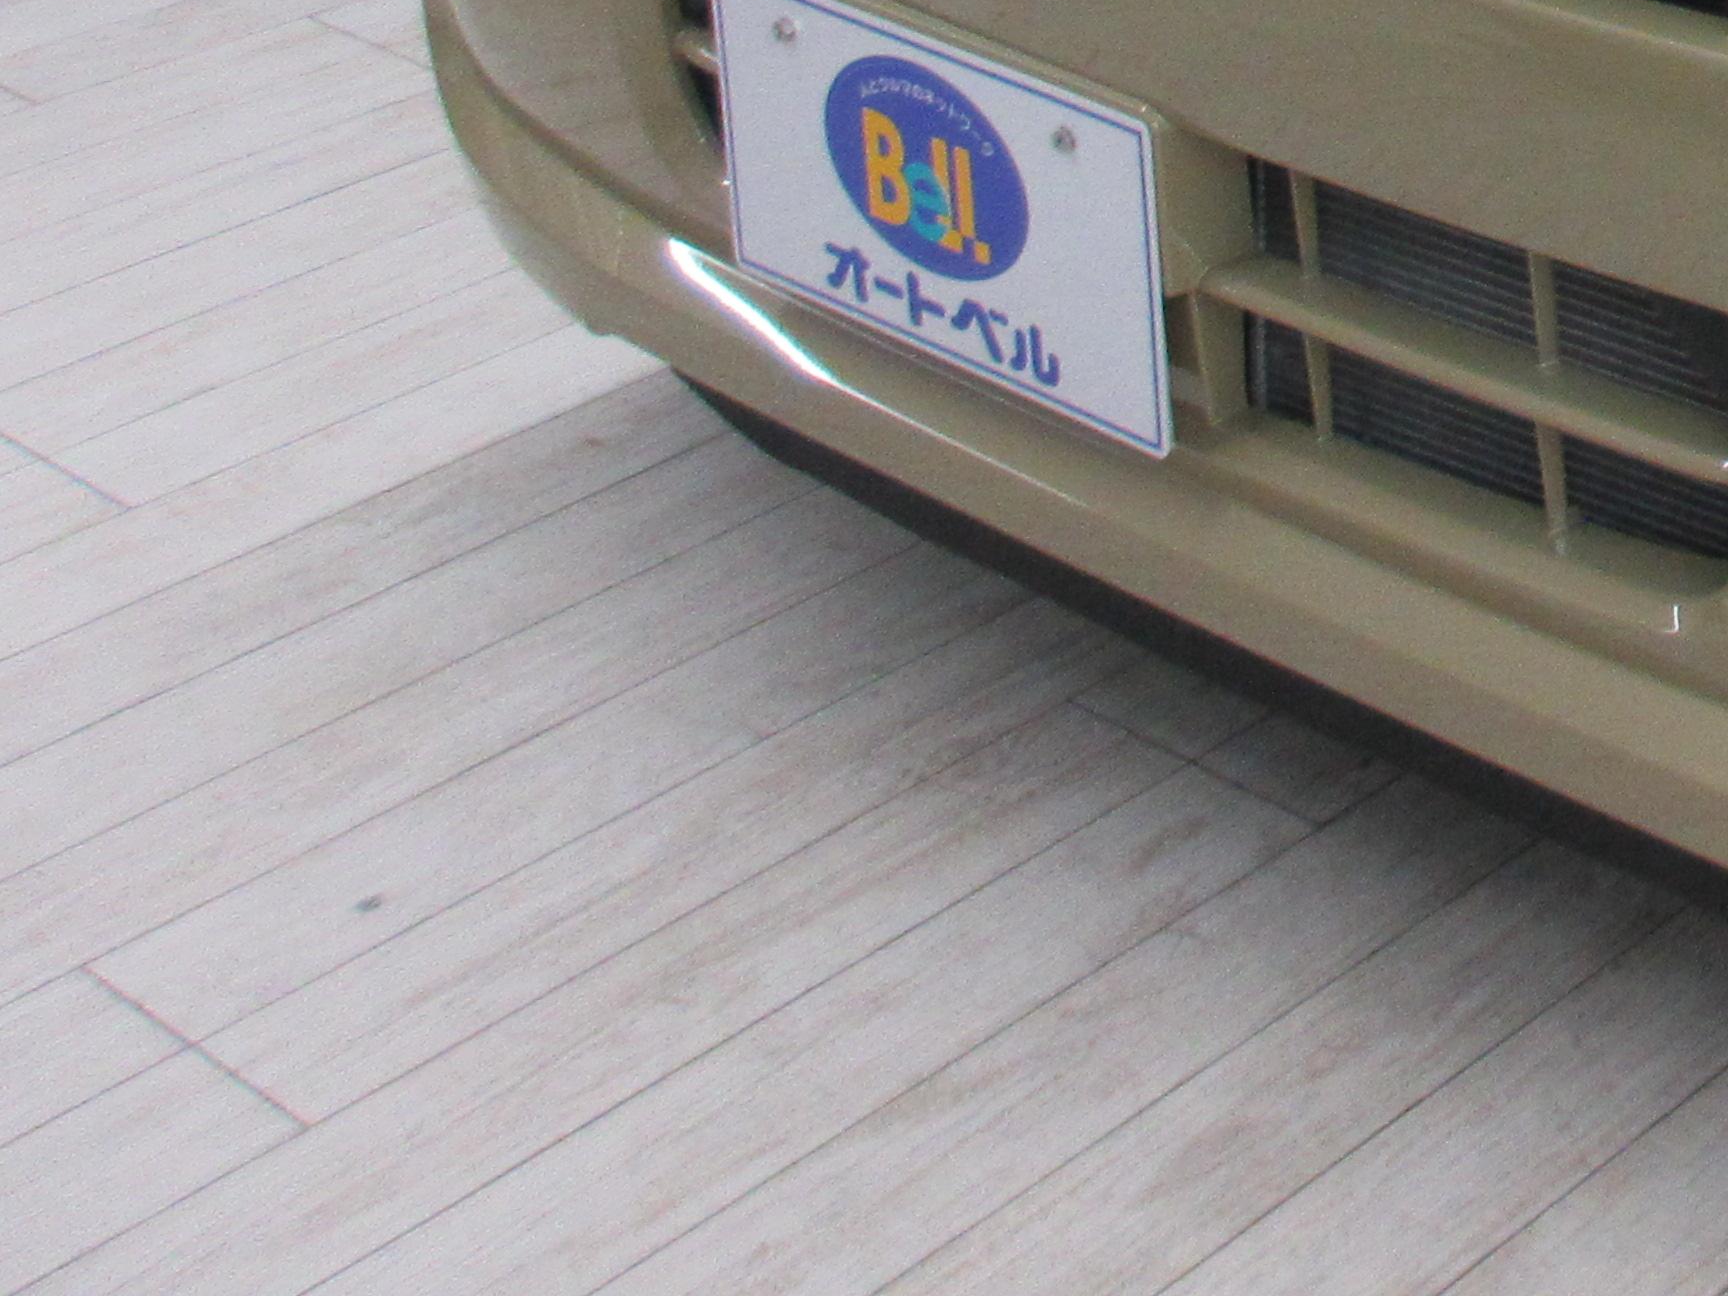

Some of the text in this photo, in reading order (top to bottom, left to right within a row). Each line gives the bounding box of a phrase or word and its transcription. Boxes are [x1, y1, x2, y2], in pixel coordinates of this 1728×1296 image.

[824, 240, 1061, 388] オートベル
